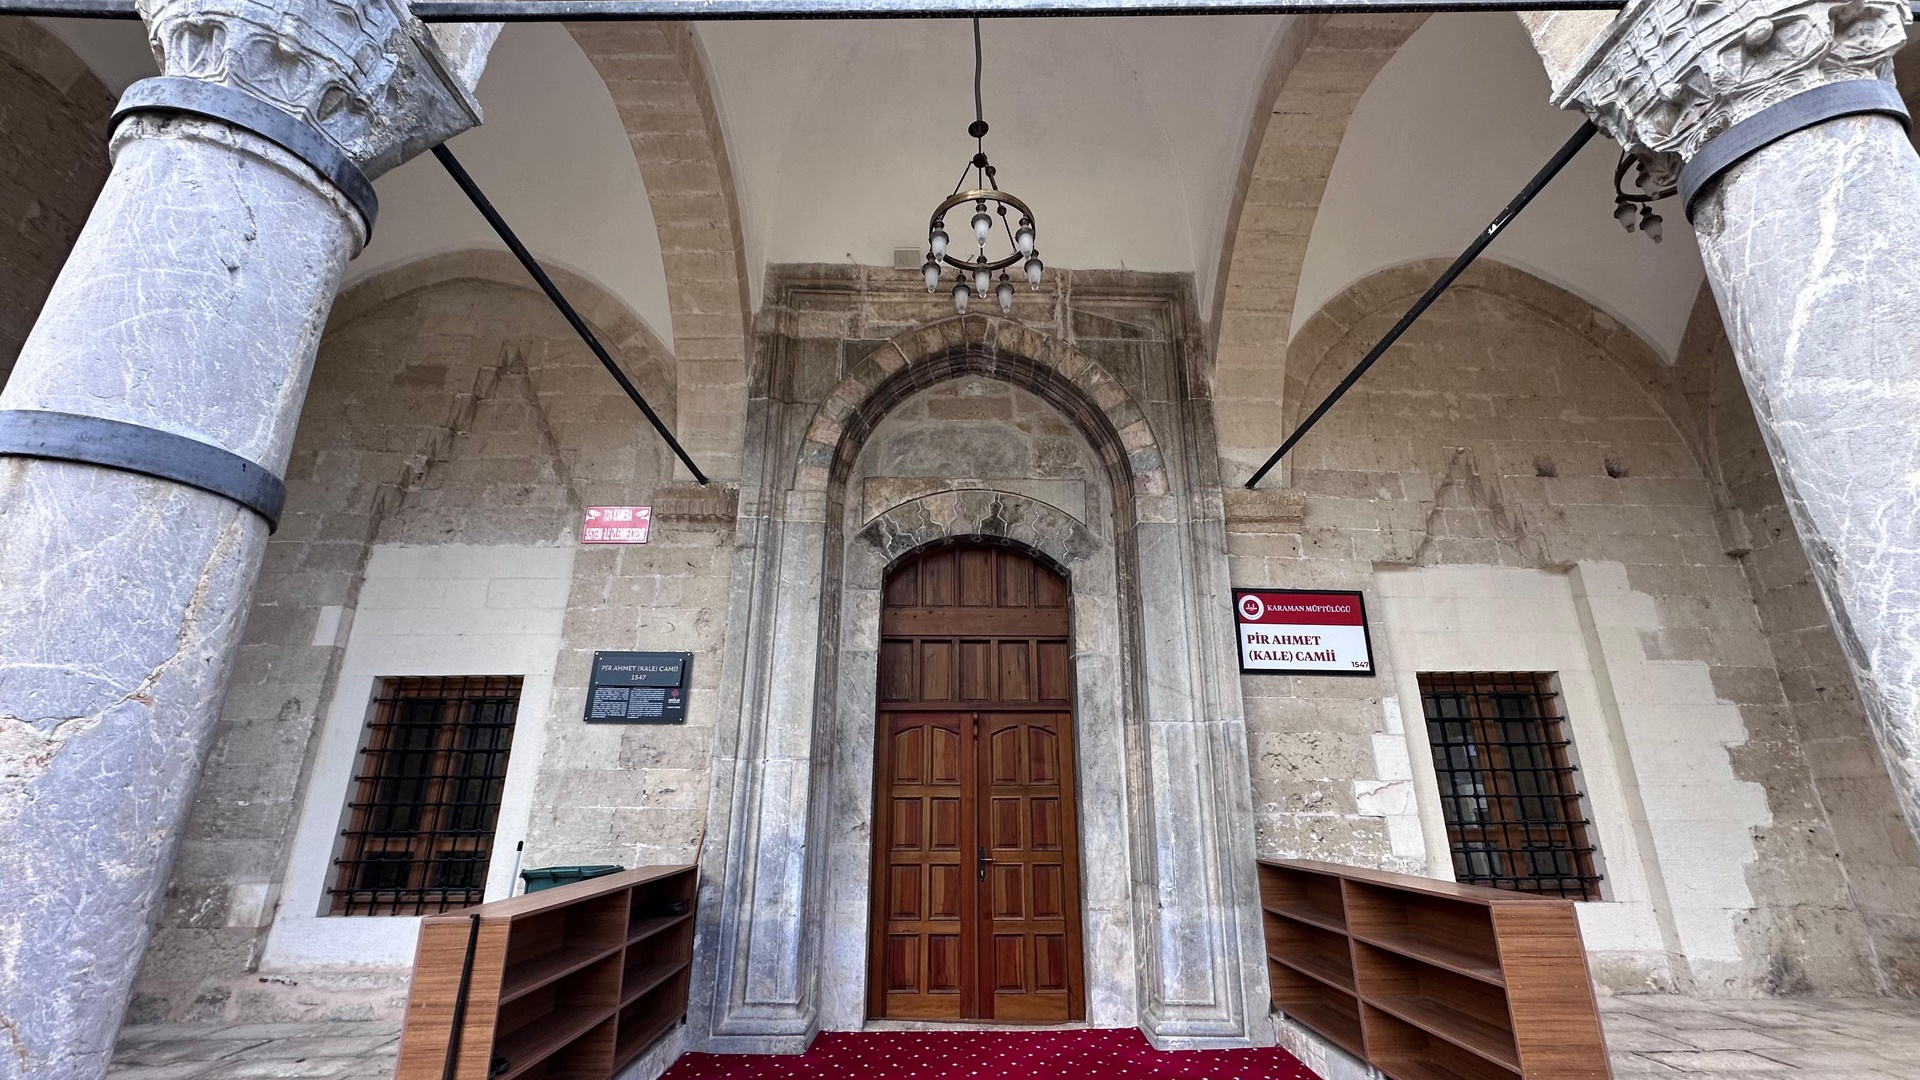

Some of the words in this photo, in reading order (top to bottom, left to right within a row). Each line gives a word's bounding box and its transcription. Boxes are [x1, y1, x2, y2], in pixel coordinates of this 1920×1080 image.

[1267, 604, 1304, 612] KARAMAN
[1305, 605, 1351, 613] MÜFTÜLÜĞÜ
[1247, 632, 1270, 644] PİR
[1272, 634, 1321, 645] AHMET
[1249, 650, 1293, 662] (KALE)
[1295, 649, 1336, 662] CAMİİ
